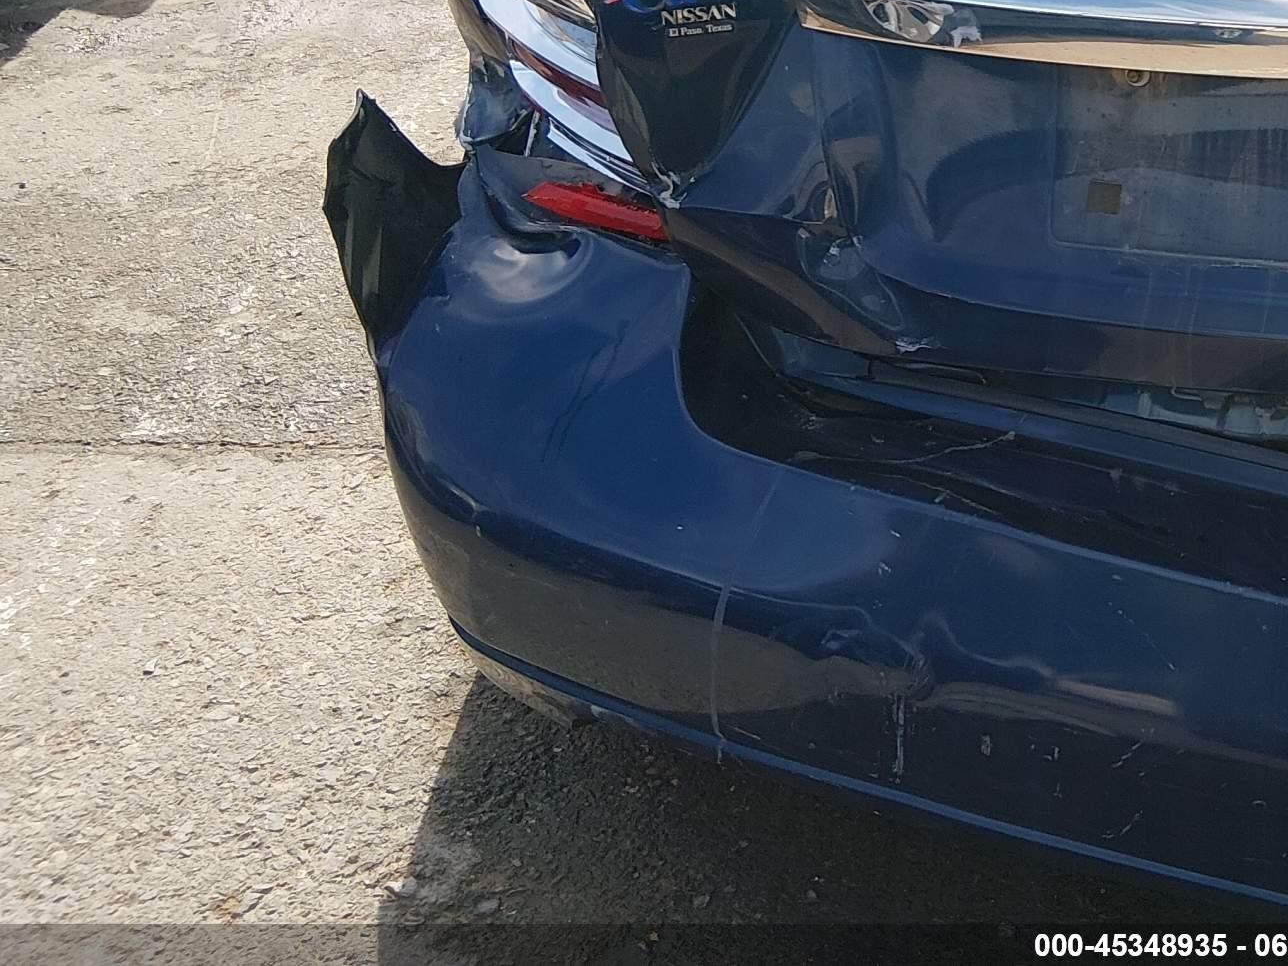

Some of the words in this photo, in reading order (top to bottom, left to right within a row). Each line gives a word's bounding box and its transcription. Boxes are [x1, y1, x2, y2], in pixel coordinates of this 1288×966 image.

[660, 2, 738, 27] NISSAN
[669, 27, 679, 37] El
[705, 23, 733, 33] Texas
